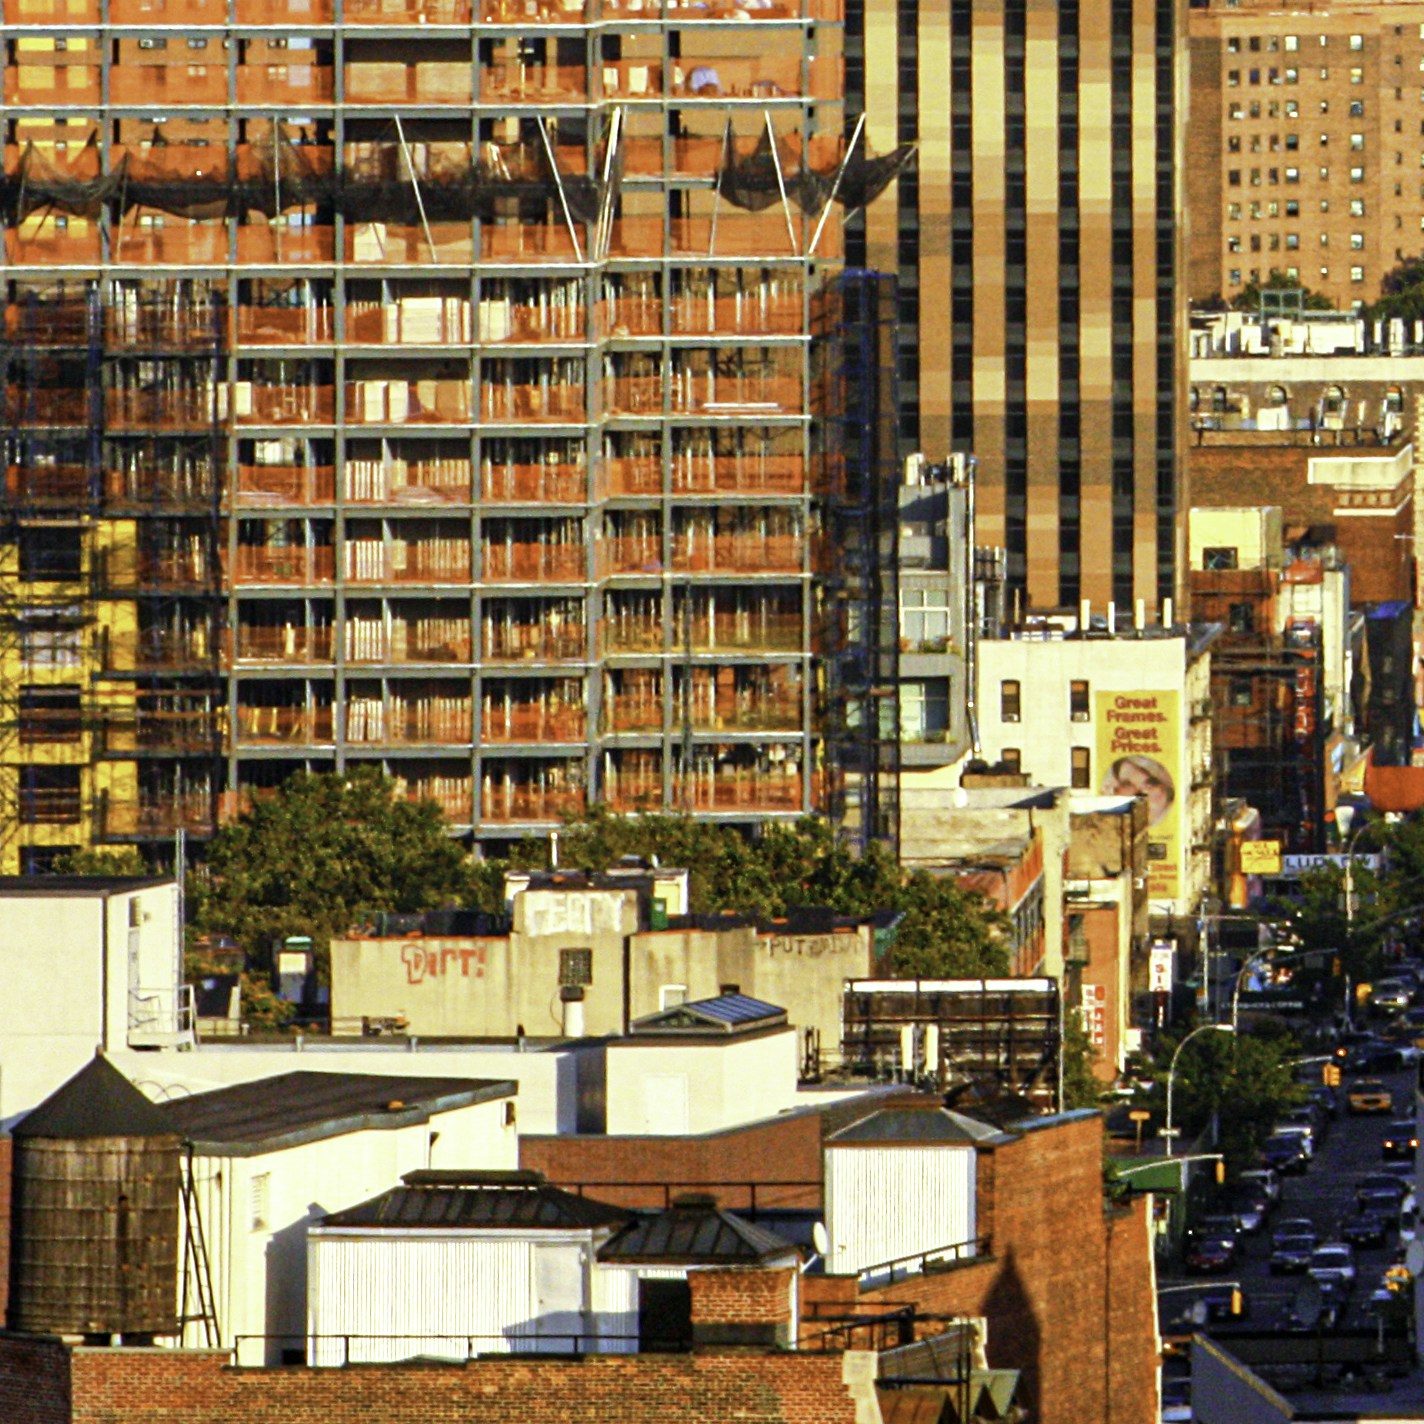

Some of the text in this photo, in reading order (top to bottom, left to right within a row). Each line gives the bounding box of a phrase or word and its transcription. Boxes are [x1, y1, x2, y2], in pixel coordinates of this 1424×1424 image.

[1115, 696, 1157, 709] Great
[1107, 710, 1167, 722] Frames.
[1115, 727, 1158, 739] Great
[1111, 740, 1162, 753] Prices.
